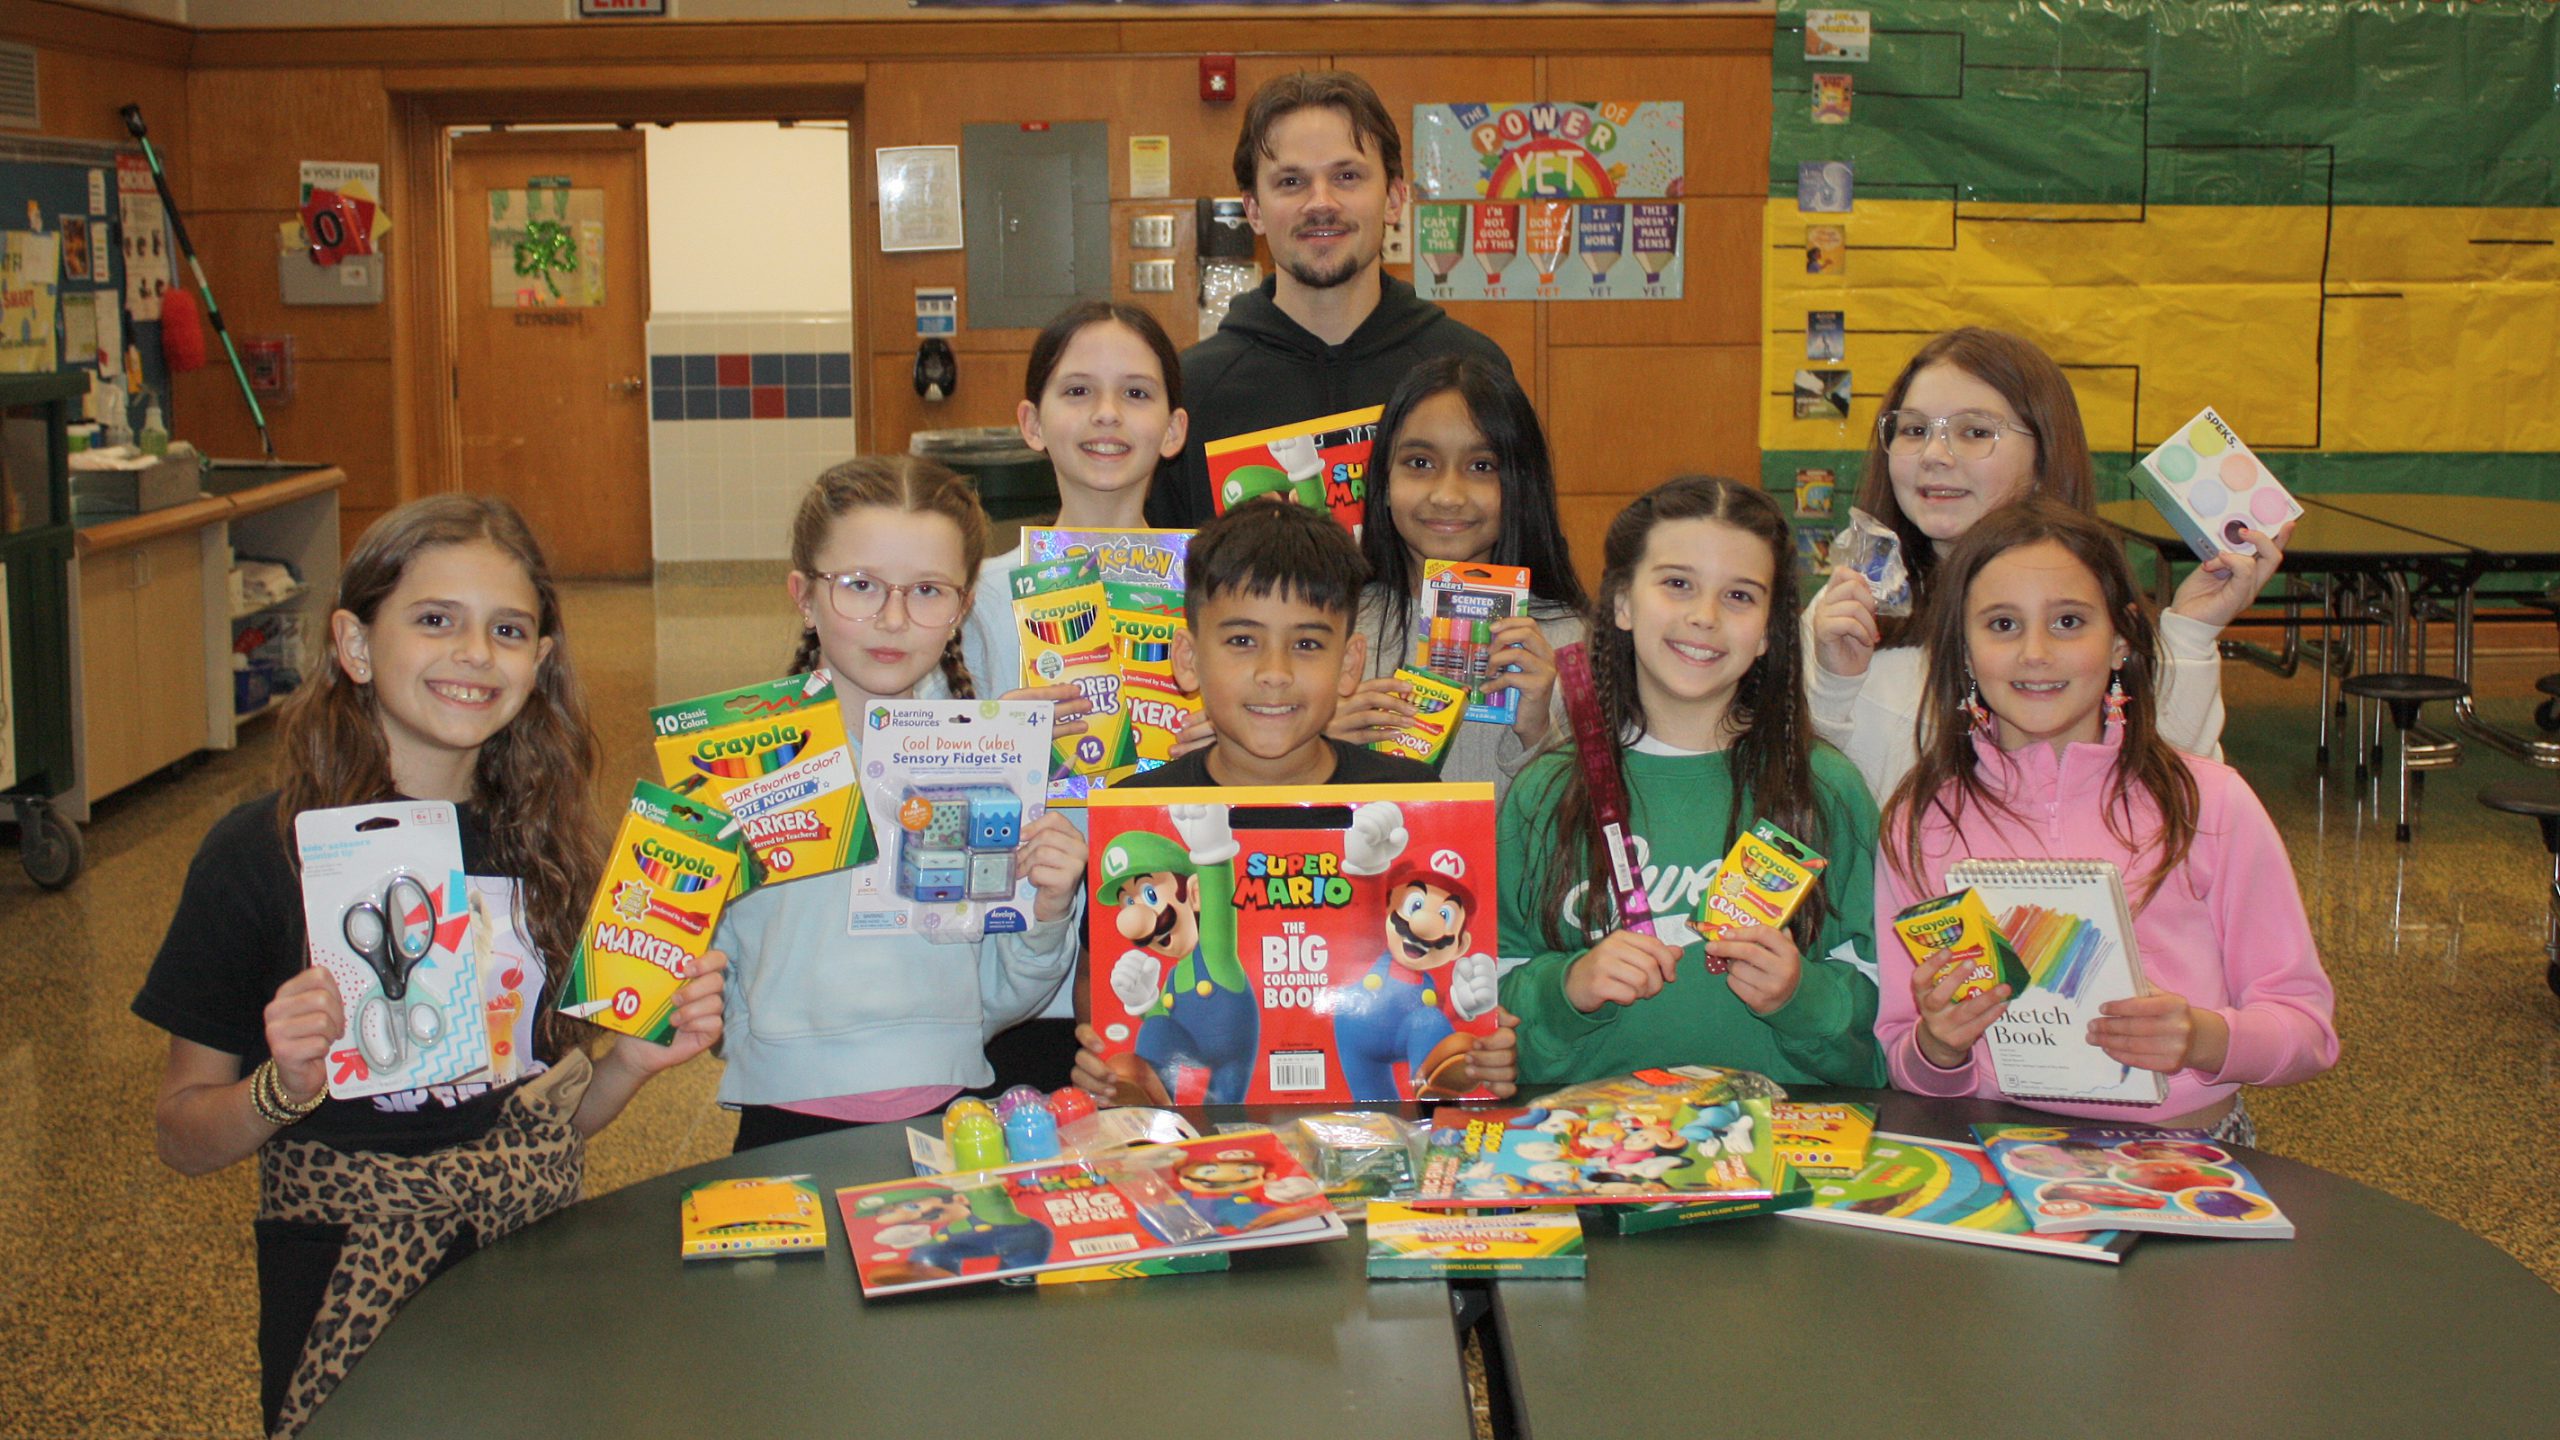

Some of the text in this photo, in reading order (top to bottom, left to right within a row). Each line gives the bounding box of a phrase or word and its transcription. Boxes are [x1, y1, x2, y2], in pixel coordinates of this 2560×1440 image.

[1461, 107, 1486, 127] THE
[1604, 103, 1628, 121] OF
[1477, 107, 1612, 151] POWER
[343, 170, 375, 179] LEVELS
[1513, 150, 1584, 194] YET
[1486, 207, 1503, 217] I'M
[1593, 208, 1607, 220] IT
[1642, 206, 1668, 215] THIS
[1423, 217, 1458, 228] CAN'T
[1484, 218, 1505, 228] NOT
[1580, 222, 1621, 233] DOESN'T
[1634, 216, 1675, 227] DOESN'T
[1432, 229, 1449, 239] DO
[1480, 229, 1510, 239] GOOD
[1641, 228, 1667, 238] MAKE
[1427, 239, 1454, 250] THIS
[1475, 240, 1514, 250] AT THIS
[1585, 236, 1615, 247] WORK
[1638, 239, 1671, 249] SENSE
[1431, 287, 1455, 298] YET
[1484, 287, 1508, 298] YET
[1536, 287, 1560, 298] YET
[1588, 287, 1613, 298] YET
[1642, 287, 1667, 298] YET
[2204, 411, 2237, 449] SPEKS.
[1516, 570, 1526, 584] 4
[1016, 576, 1036, 595] 12
[1431, 581, 1462, 591] ELMER'S
[1451, 594, 1494, 606] SCENTED
[1030, 600, 1091, 621] Crayola
[1456, 605, 1489, 615] STICKS
[678, 708, 707, 721] Classic
[893, 709, 934, 719] Learning
[1027, 711, 1047, 727] 4+
[656, 715, 679, 735] 10
[680, 718, 709, 730] Colors
[892, 718, 940, 727] Resources
[697, 725, 799, 761] Crayola
[902, 735, 1015, 752] Cool Down Cubes
[1081, 741, 1100, 760] 12
[893, 752, 1022, 766] Sensory Fidget Set
[725, 751, 841, 806] OUR Favorite Color?
[631, 797, 647, 815] 10
[733, 785, 806, 820] OTE NOW!
[746, 810, 820, 840] ARKERS
[785, 830, 818, 841] Teachers!
[1756, 826, 1774, 840] 24
[641, 837, 715, 879] Crayola
[770, 850, 792, 869] 10
[1247, 852, 1338, 876] SUPER
[1748, 845, 1796, 881] Crayola
[865, 878, 871, 887] 5
[1232, 876, 1352, 909] MARIO
[1282, 922, 1305, 934] THE
[1909, 915, 1957, 934] Crayola
[1262, 935, 1328, 972] BIG
[1264, 974, 1328, 986] COLORING
[615, 991, 639, 1015] 10
[1994, 1025, 2057, 1046] Book
[2101, 1129, 2197, 1140] PIXAR
[1427, 1231, 1529, 1242] MARKERS
[1464, 1242, 1488, 1252] 10
[1439, 1263, 1468, 1271] CRAYOLA
